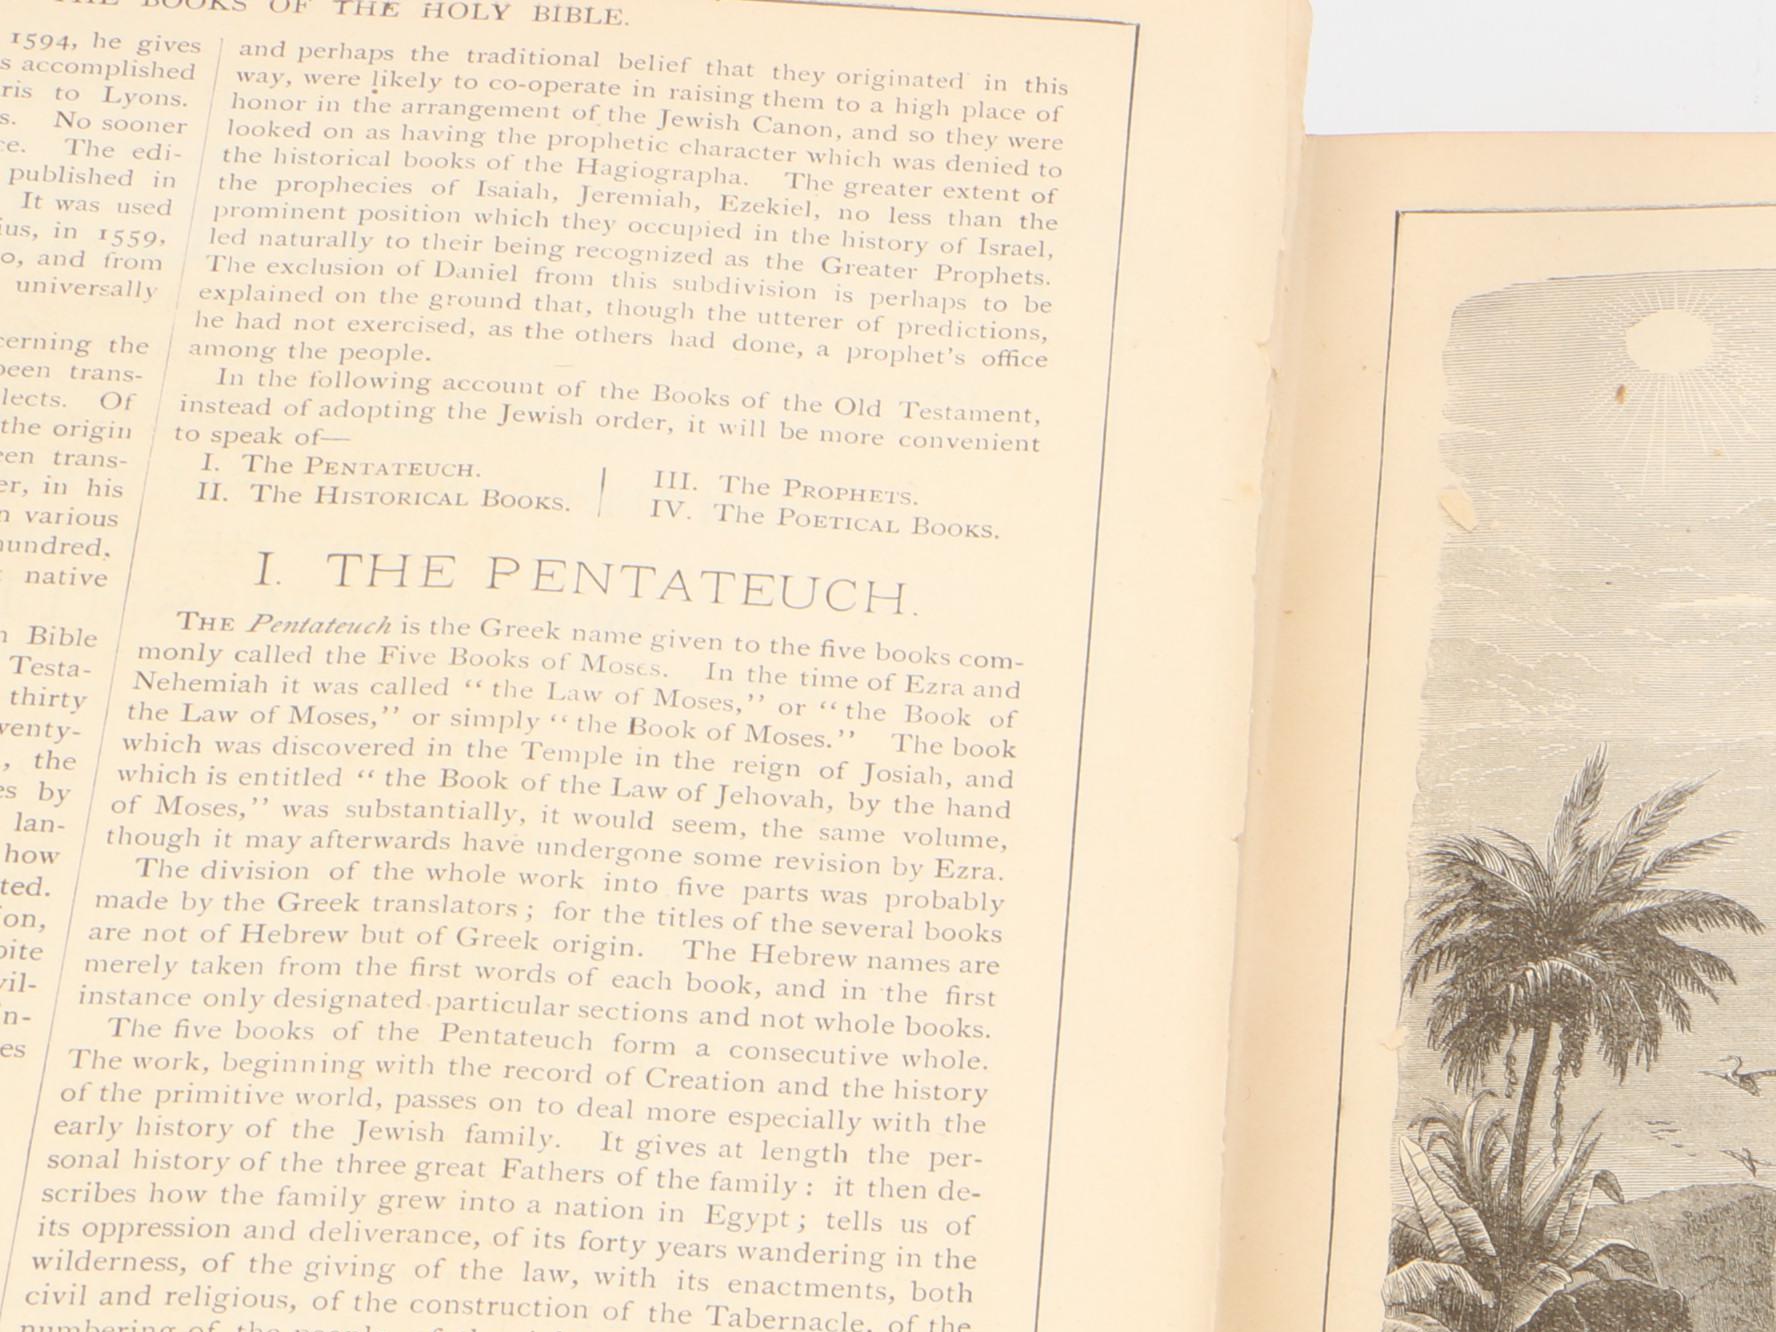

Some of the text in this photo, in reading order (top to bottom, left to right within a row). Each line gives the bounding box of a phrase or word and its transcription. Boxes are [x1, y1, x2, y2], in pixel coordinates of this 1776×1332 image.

[332, 0, 400, 18] THE
[422, 1, 511, 21] HOLY
[533, 4, 629, 26] BIBLE.
[12, 31, 201, 57] 1594, he gives
[239, 40, 1069, 96] and perhaps the traditional belief that they originated in this
[8, 164, 176, 188] published in
[16, 276, 158, 299] universally
[189, 341, 431, 367] among the people.
[201, 452, 481, 478] I. The PENTATEUCH.
[196, 481, 570, 512] II. The HISTORICAL BOOKS.
[655, 470, 918, 506] III. The PROPHETS.
[25, 506, 119, 528] various
[650, 498, 999, 540] IV. The POETICAL BOOKS.
[24, 566, 108, 588] native
[254, 551, 919, 617] I. THE PENTATEUCH.
[27, 625, 98, 648] Bible
[176, 610, 1024, 670] THE Pentateuch is the Greek name given to the five books com-
[107, 1016, 988, 1071] The five books of the Pentateuch form a consecutive whole.
